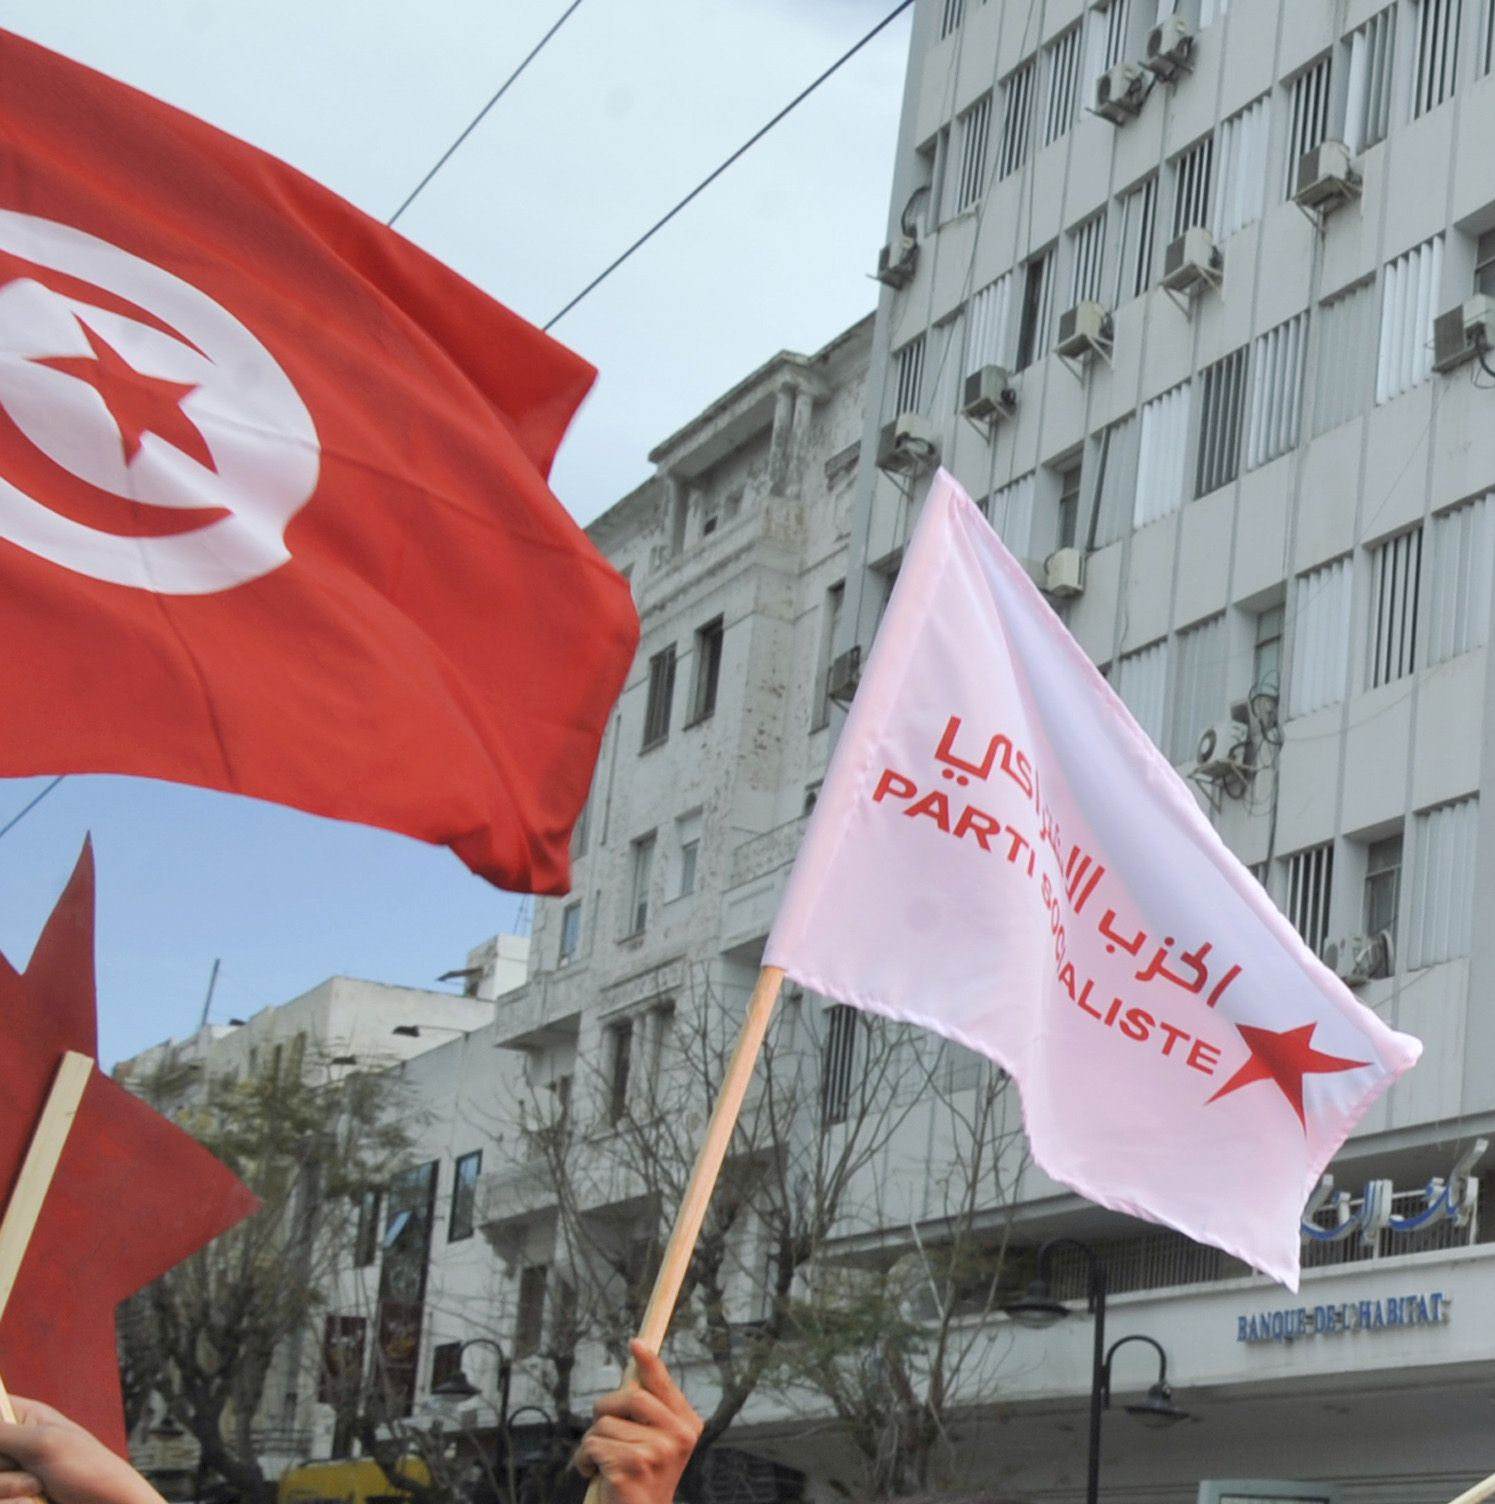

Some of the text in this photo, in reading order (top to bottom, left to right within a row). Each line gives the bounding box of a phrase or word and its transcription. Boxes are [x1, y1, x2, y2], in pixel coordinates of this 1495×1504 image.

[871, 768, 1036, 877] PARTI
[1237, 1308, 1307, 1342] BANQUE
[1315, 1304, 1336, 1334] DE
